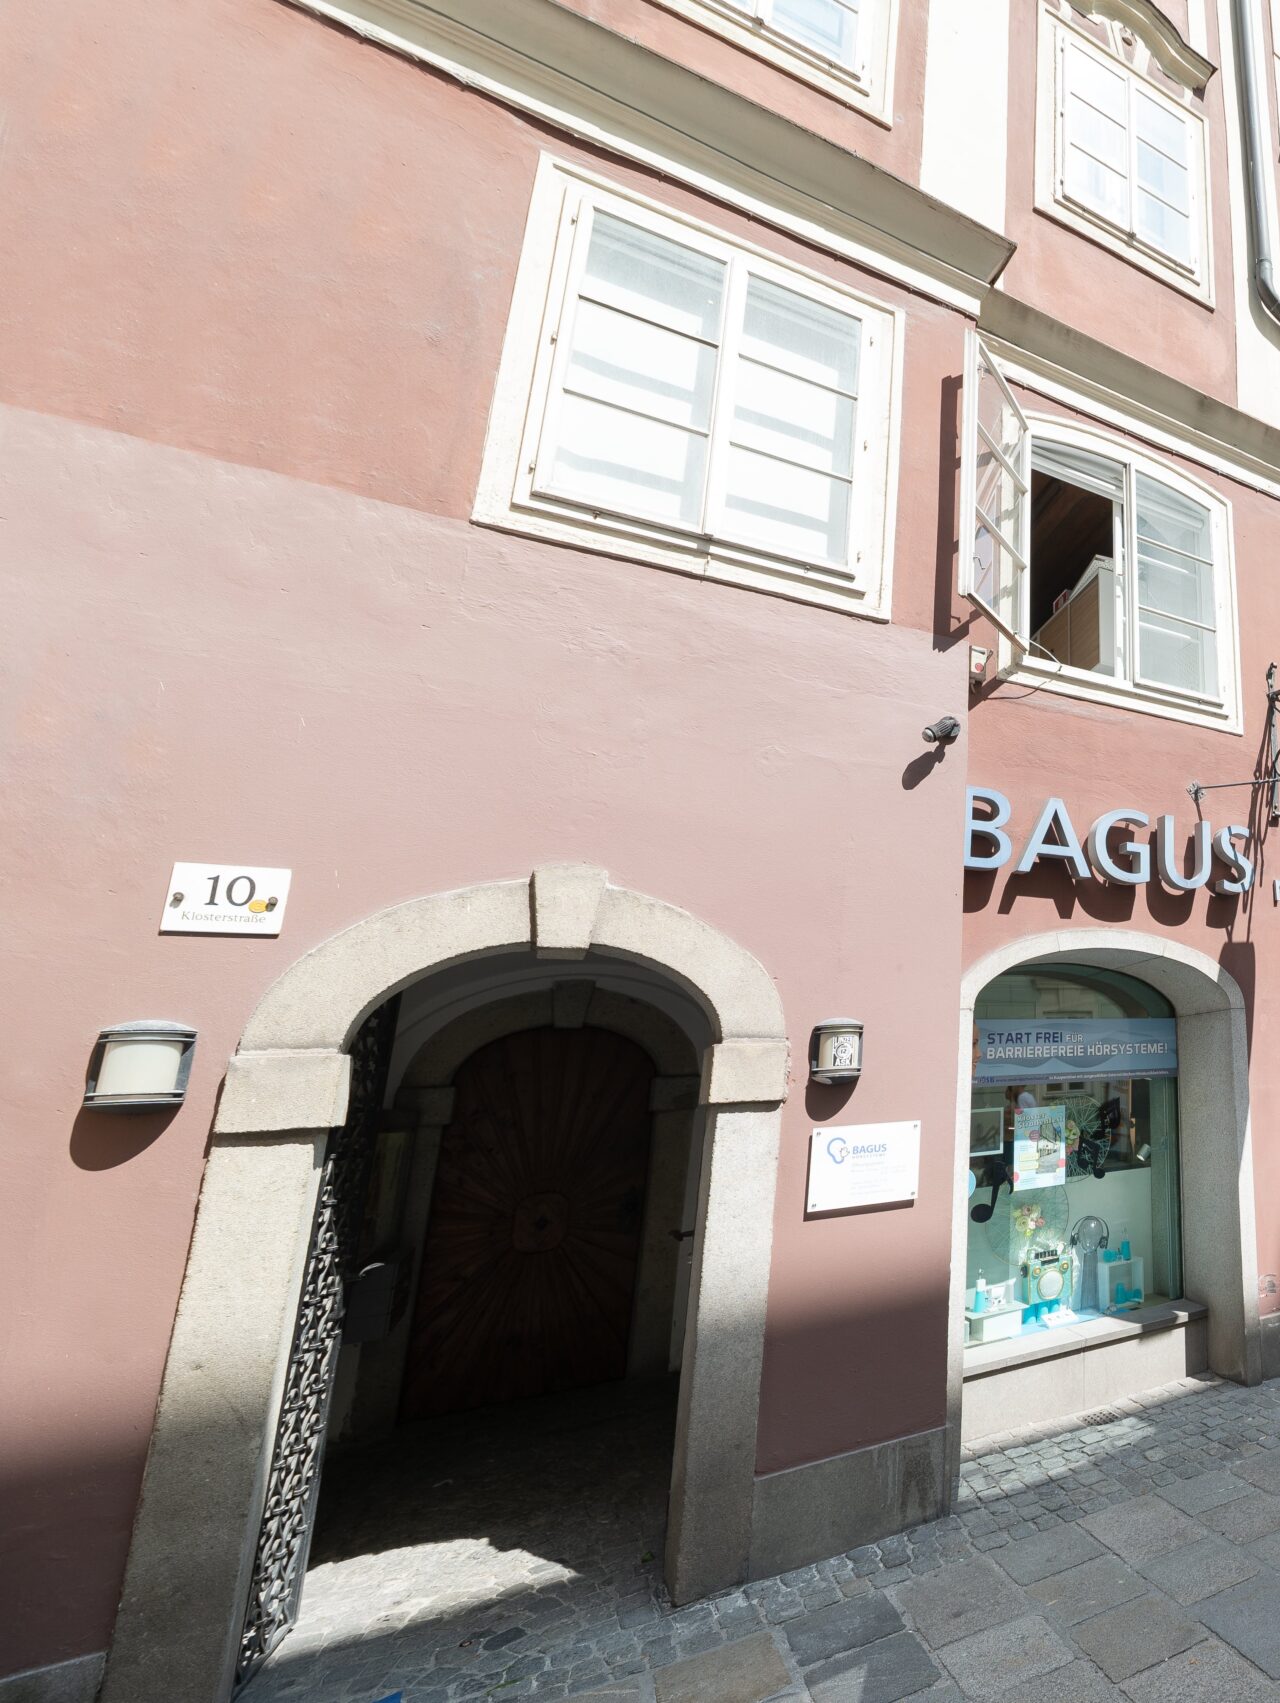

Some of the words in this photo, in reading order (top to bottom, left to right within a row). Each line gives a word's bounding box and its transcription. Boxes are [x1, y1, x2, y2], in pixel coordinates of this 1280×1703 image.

[963, 784, 1255, 896] BAGUS
[203, 874, 256, 907] 10
[181, 910, 266, 924] Klosterstraße
[987, 1032, 1032, 1045] START
[1035, 1031, 1063, 1044] FREI
[1066, 1032, 1084, 1043] FÜR
[986, 1045, 1085, 1060] BARRIEREFREIE
[1087, 1042, 1169, 1057] HÖRSYSTEME!
[852, 1143, 887, 1155] BAGUS
